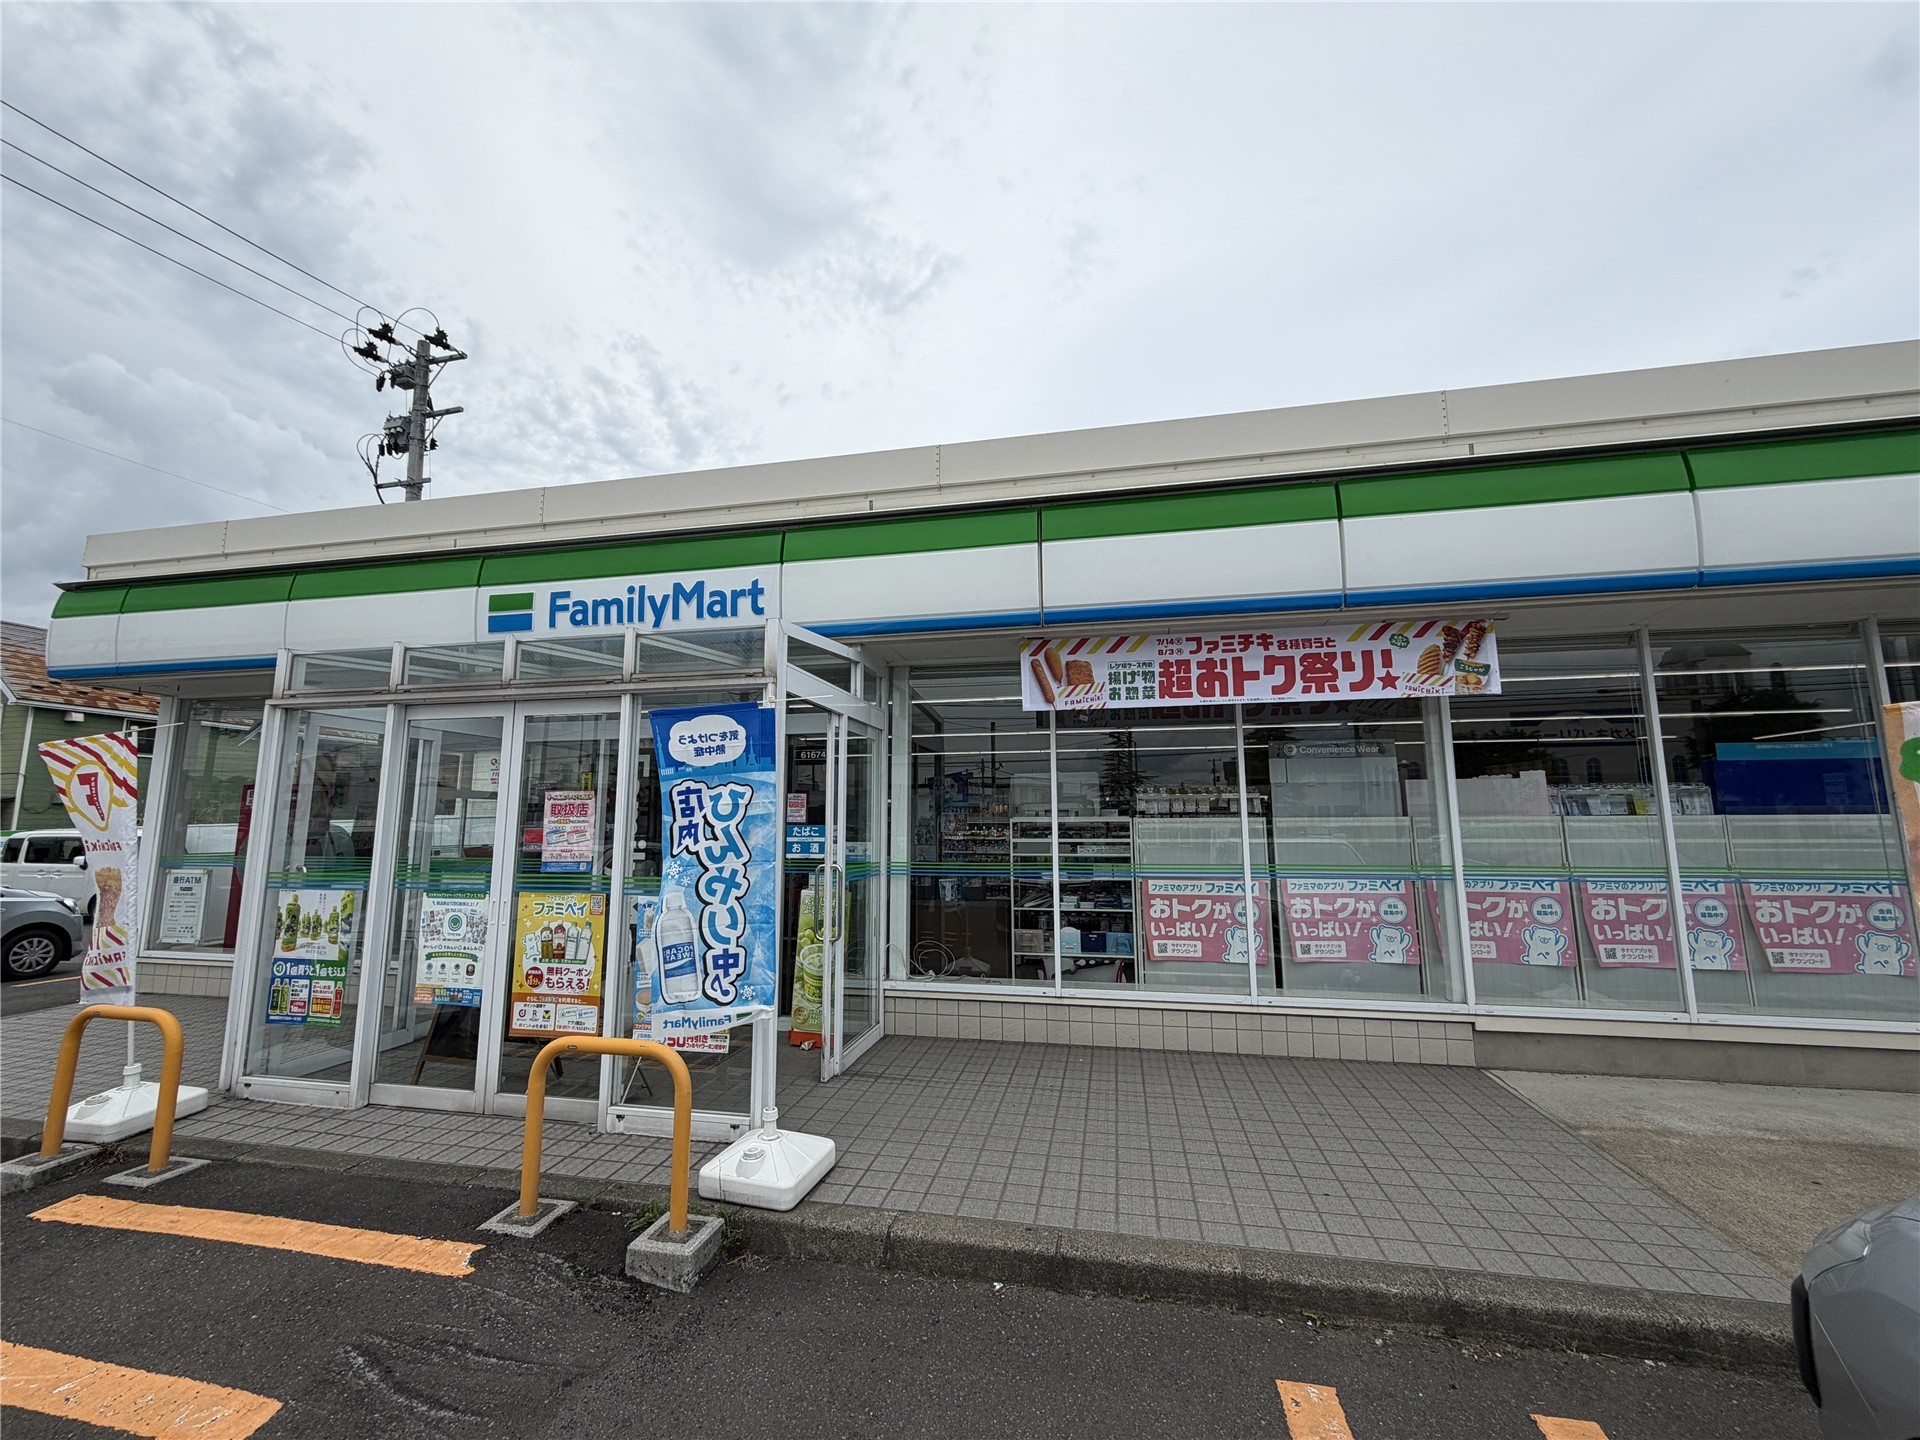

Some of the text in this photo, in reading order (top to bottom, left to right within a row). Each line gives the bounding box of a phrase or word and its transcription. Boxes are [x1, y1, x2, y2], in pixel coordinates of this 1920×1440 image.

[549, 578, 765, 628] FamilyMart
[1108, 670, 1156, 686] 揚げ物
[1109, 686, 1156, 701] お惣菜
[1300, 744, 1380, 754] Convenience Wear
[551, 803, 589, 818] 取扱店
[792, 826, 820, 837] たばこ
[173, 876, 201, 885] 銀行ATM
[1151, 883, 1202, 891] ファミマのアプリ
[1290, 880, 1402, 891] ファミマのアプリ ファミペイ
[1591, 882, 1653, 891] ファミマのアプリ
[1755, 884, 1821, 893] ファミマのアプリ
[534, 901, 588, 917] ファミペイ
[1149, 898, 1232, 920] おトクが
[1290, 897, 1376, 919] おトクが
[1591, 898, 1692, 921] おトク
[1755, 899, 1863, 924] おトクが
[1150, 921, 1218, 938] いっぱい!
[1292, 921, 1361, 937] いっぱい!
[1759, 927, 1845, 945] いっぱい!
[1537, 951, 1550, 959] ペ
[1703, 955, 1717, 963] ペ
[1874, 960, 1889, 968] ペ
[546, 967, 592, 977] 無料クーポン
[545, 977, 591, 990] もらえる!
